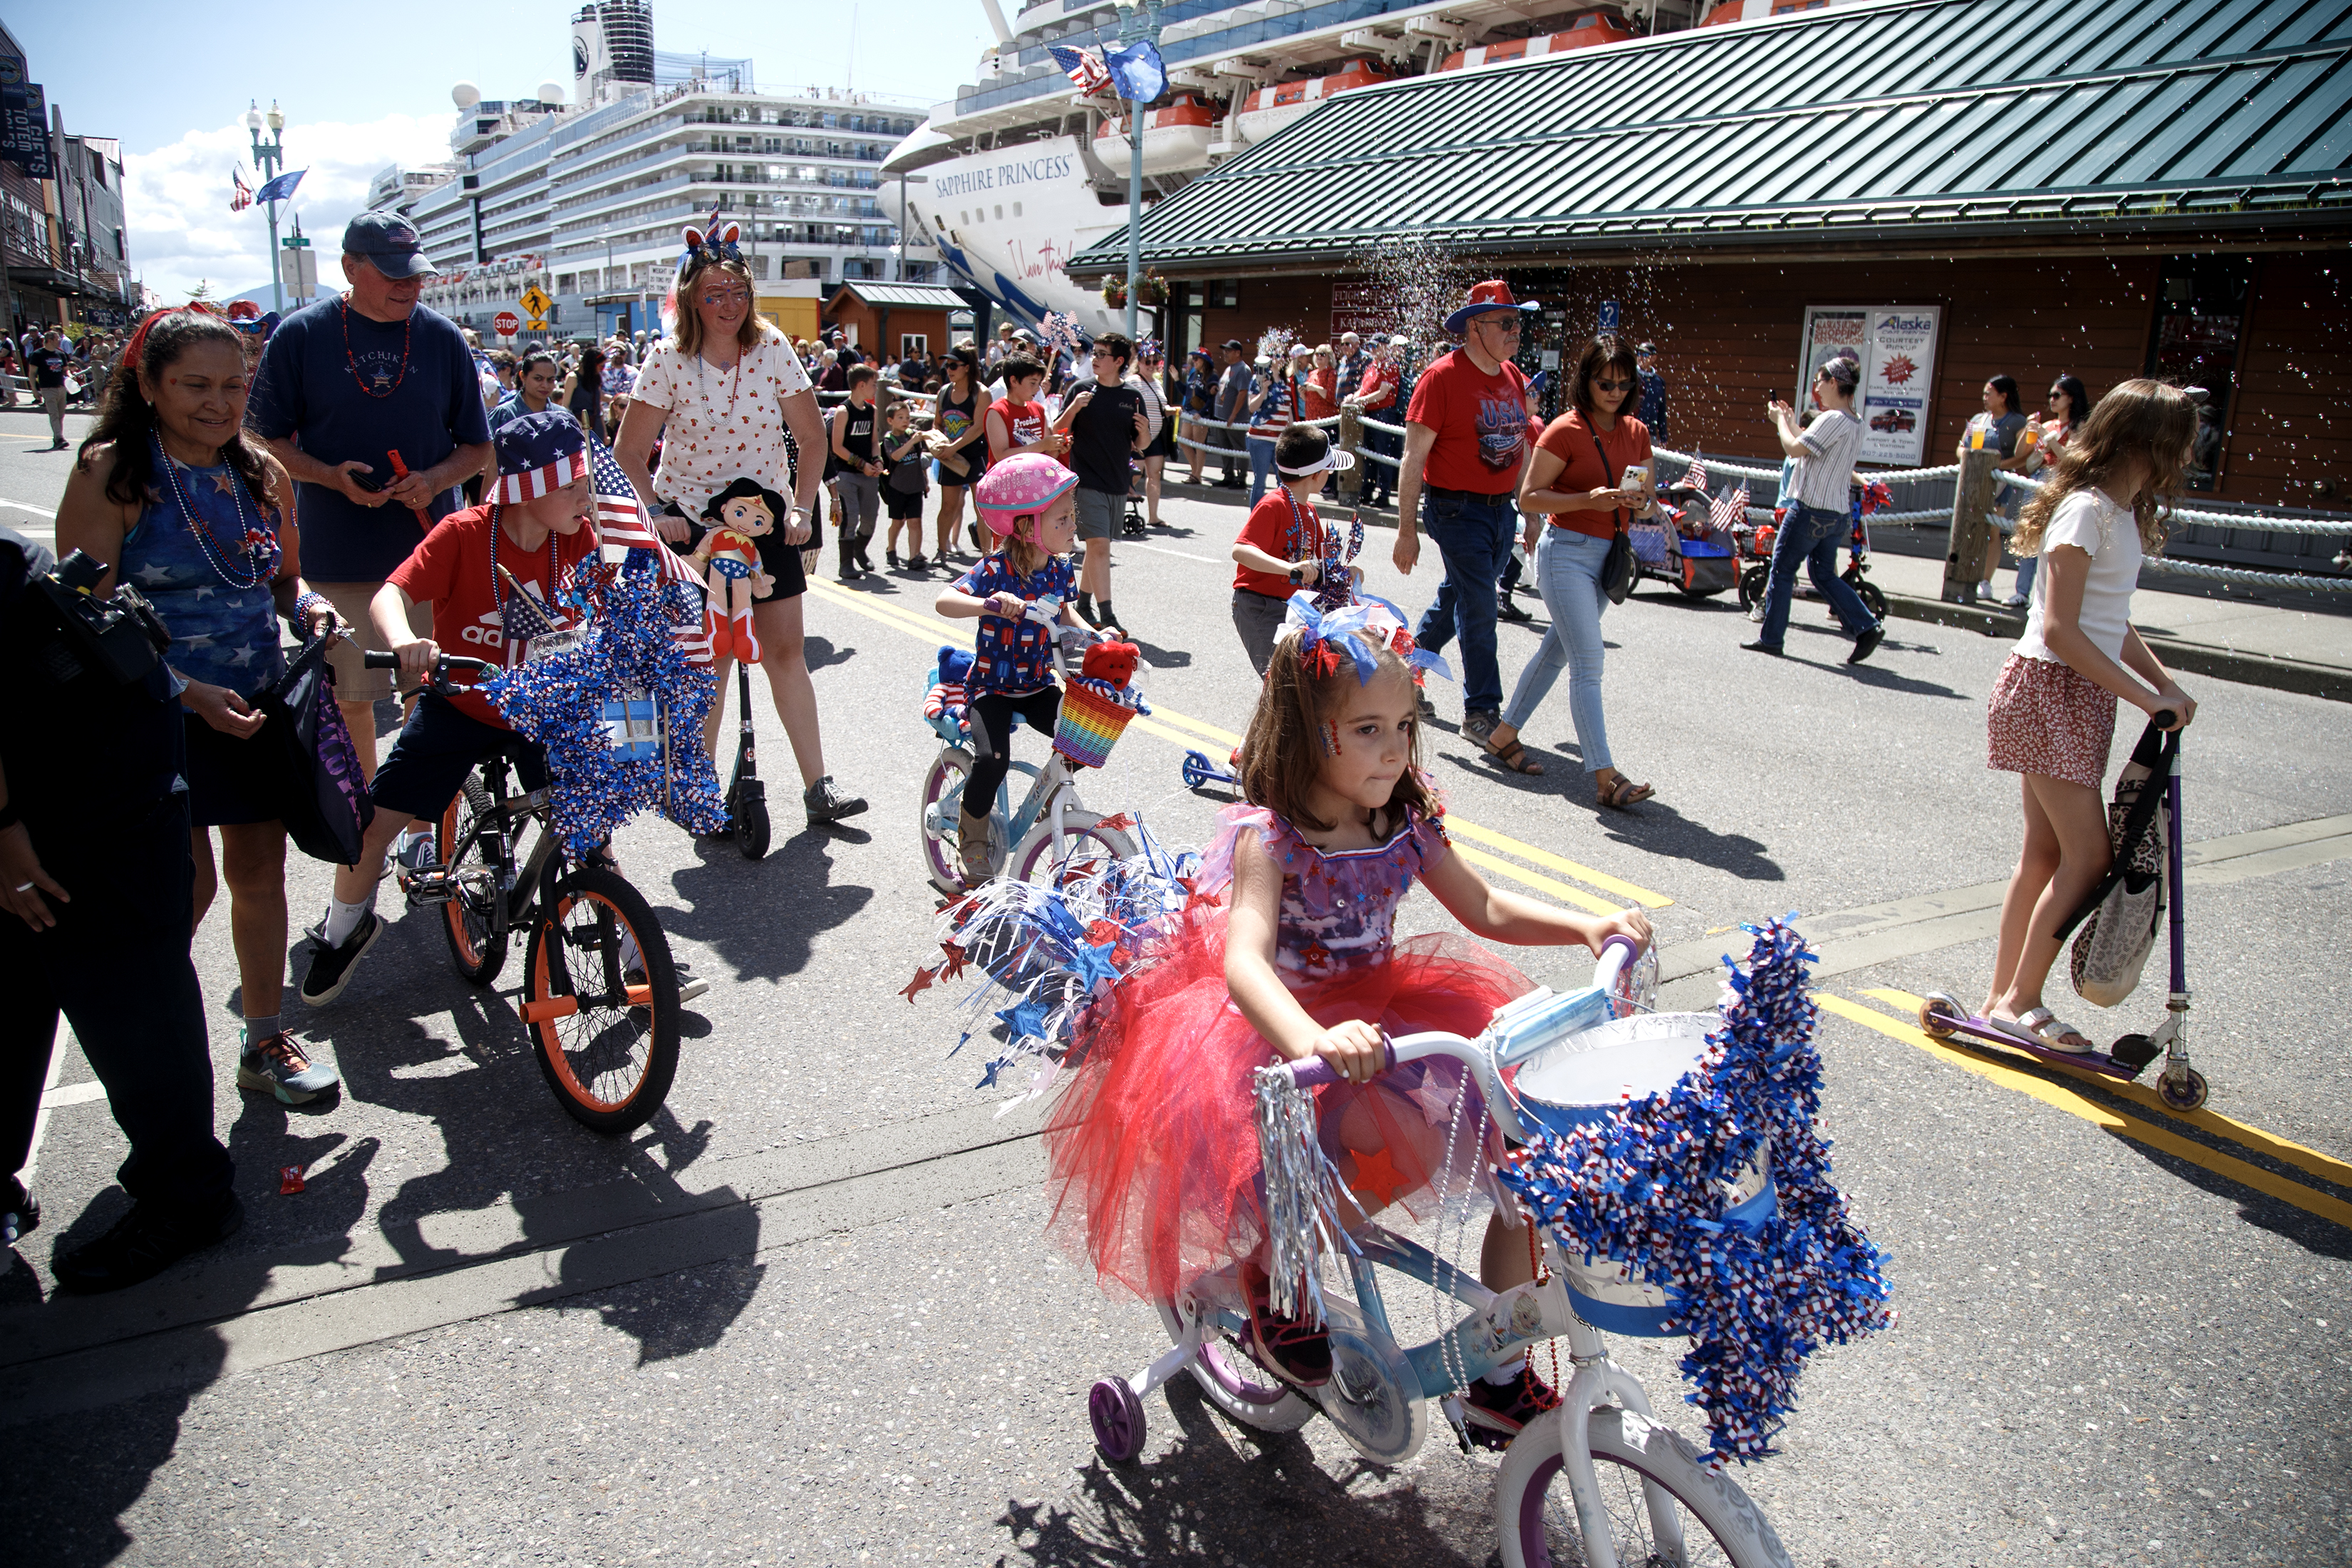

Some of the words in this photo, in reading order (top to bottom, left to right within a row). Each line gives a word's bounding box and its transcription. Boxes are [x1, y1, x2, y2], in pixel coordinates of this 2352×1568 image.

[14, 108, 33, 153] TOTEM
[936, 167, 994, 198] SAPPHIRE
[998, 154, 1071, 187] PRINCESS
[495, 319, 518, 329] STOP
[1842, 320, 1865, 331] ULTIMAT
[1876, 316, 1931, 330] Alaska
[1814, 336, 1863, 346] DESTINATION
[1815, 328, 1864, 340] SHOPPING
[344, 351, 419, 374] KETCHIKN
[1479, 398, 1527, 429] USA
[850, 421, 871, 435] NIK
[1013, 416, 1041, 428] Freedom
